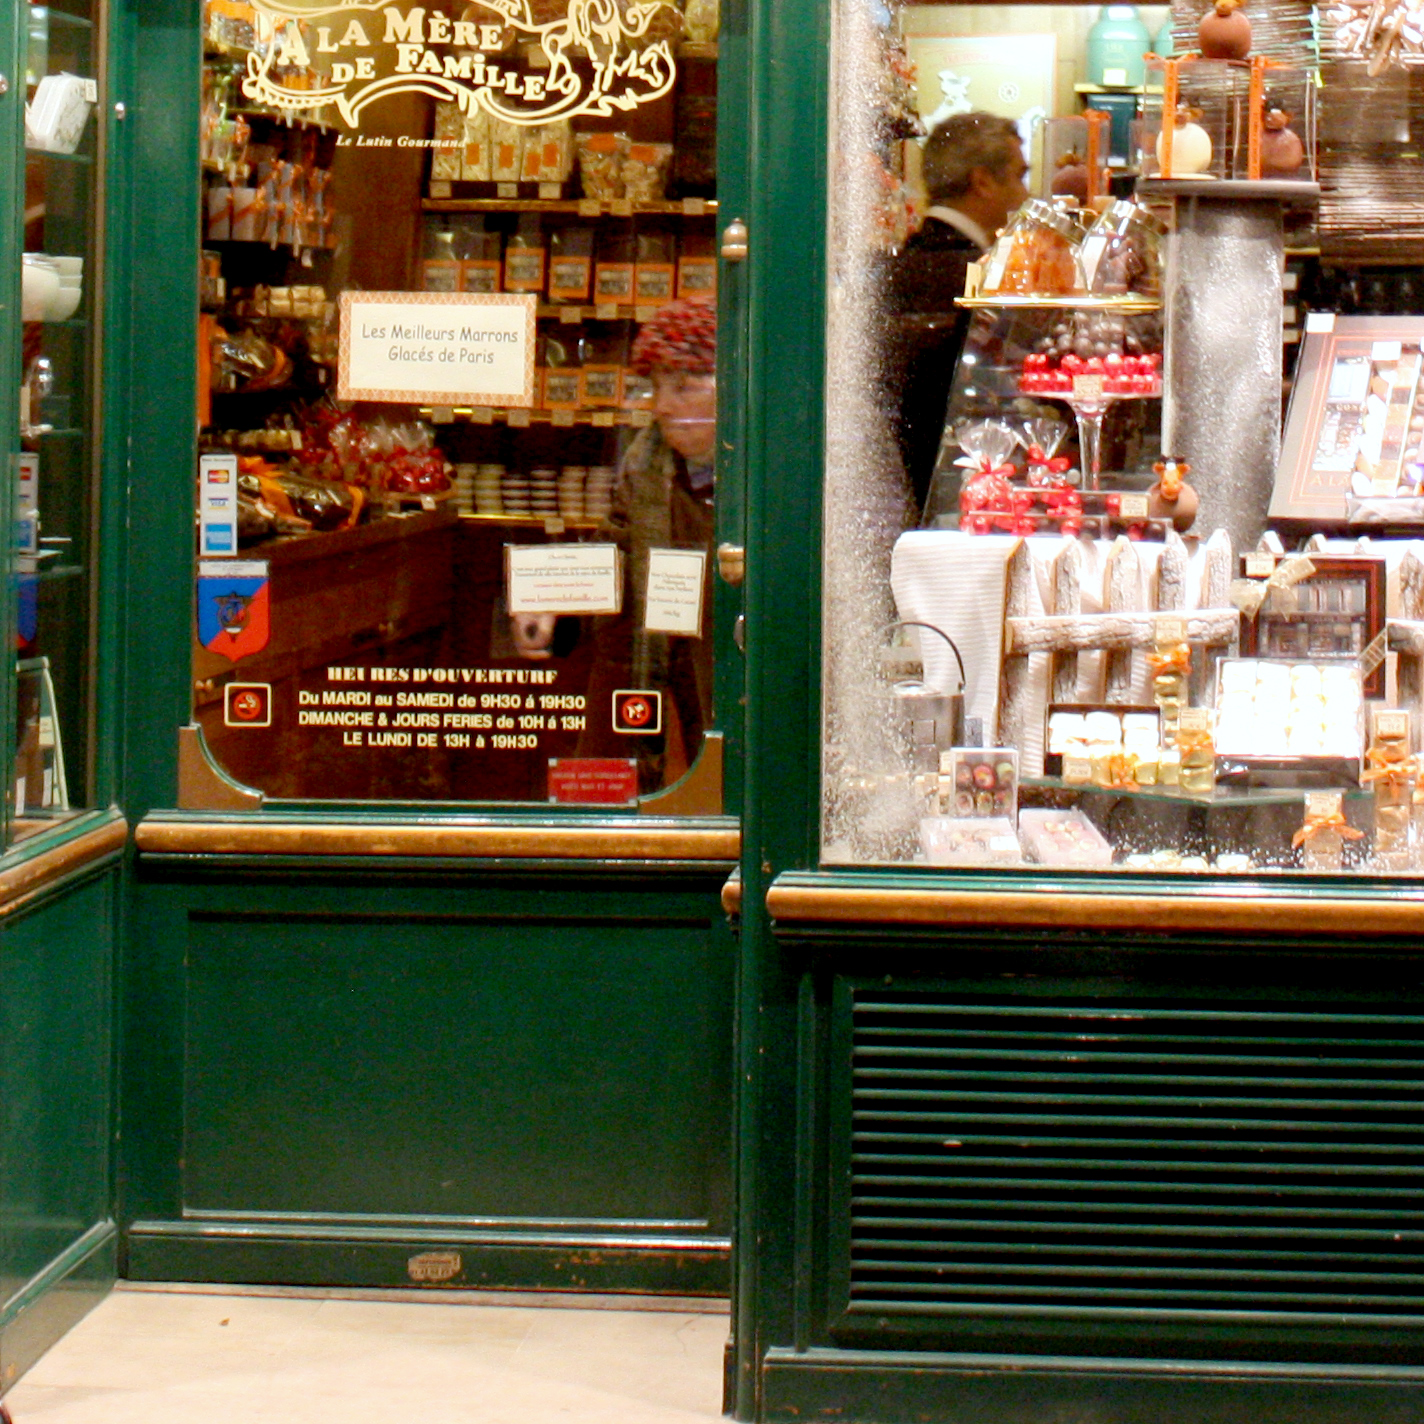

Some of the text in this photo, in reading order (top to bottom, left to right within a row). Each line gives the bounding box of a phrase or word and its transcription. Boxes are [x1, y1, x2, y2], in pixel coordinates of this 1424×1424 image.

[277, 20, 310, 66] A
[316, 19, 371, 53] LA
[331, 57, 376, 84] DE
[335, 135, 466, 149] Le Lutin Gourmand
[362, 323, 519, 343] Les Meilleurs Marrons
[388, 345, 495, 364] Glacés de Paris
[298, 690, 319, 706] Du
[322, 691, 371, 707] MARDI
[375, 695, 393, 707] au
[396, 692, 454, 709] SAMEDI
[457, 693, 476, 709] de
[480, 693, 521, 709] 9H30
[539, 694, 586, 710] 19H30
[298, 711, 374, 727] DIMANCHE
[377, 712, 388, 727] &
[391, 713, 440, 728] JOURS
[443, 713, 492, 729] FERIES
[496, 714, 514, 729] de
[518, 714, 545, 730] 10H
[561, 715, 587, 731] 13H
[343, 732, 362, 746] LE
[367, 732, 412, 748] LUNDI
[417, 733, 438, 748] DE
[443, 733, 471, 748] 13H
[490, 734, 539, 749] 19H30
